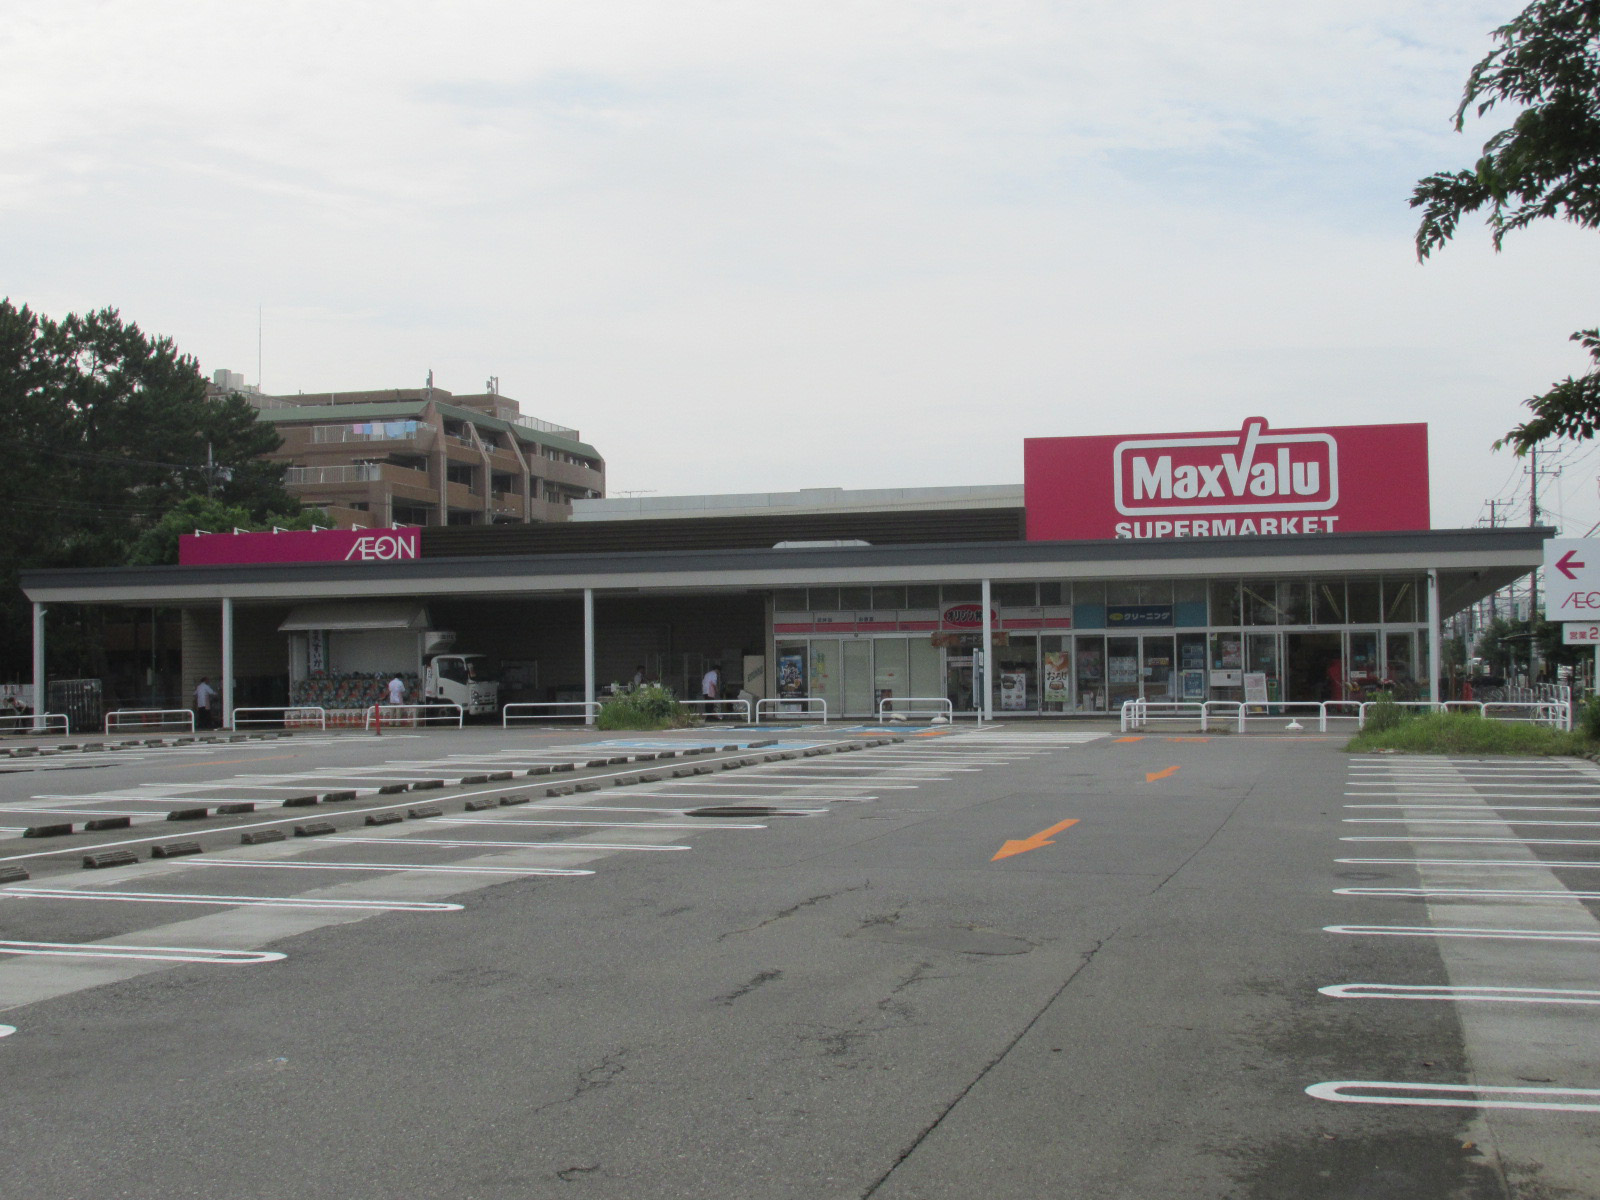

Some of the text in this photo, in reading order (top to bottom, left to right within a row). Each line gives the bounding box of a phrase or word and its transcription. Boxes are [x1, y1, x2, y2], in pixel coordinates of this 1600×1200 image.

[1132, 422, 1319, 500] MaxValu
[1115, 516, 1339, 539] SUPERMARKET
[948, 609, 984, 623] オリジン弁
[1124, 612, 1170, 620] クリーニング
[1570, 627, 1600, 640] 営業2
